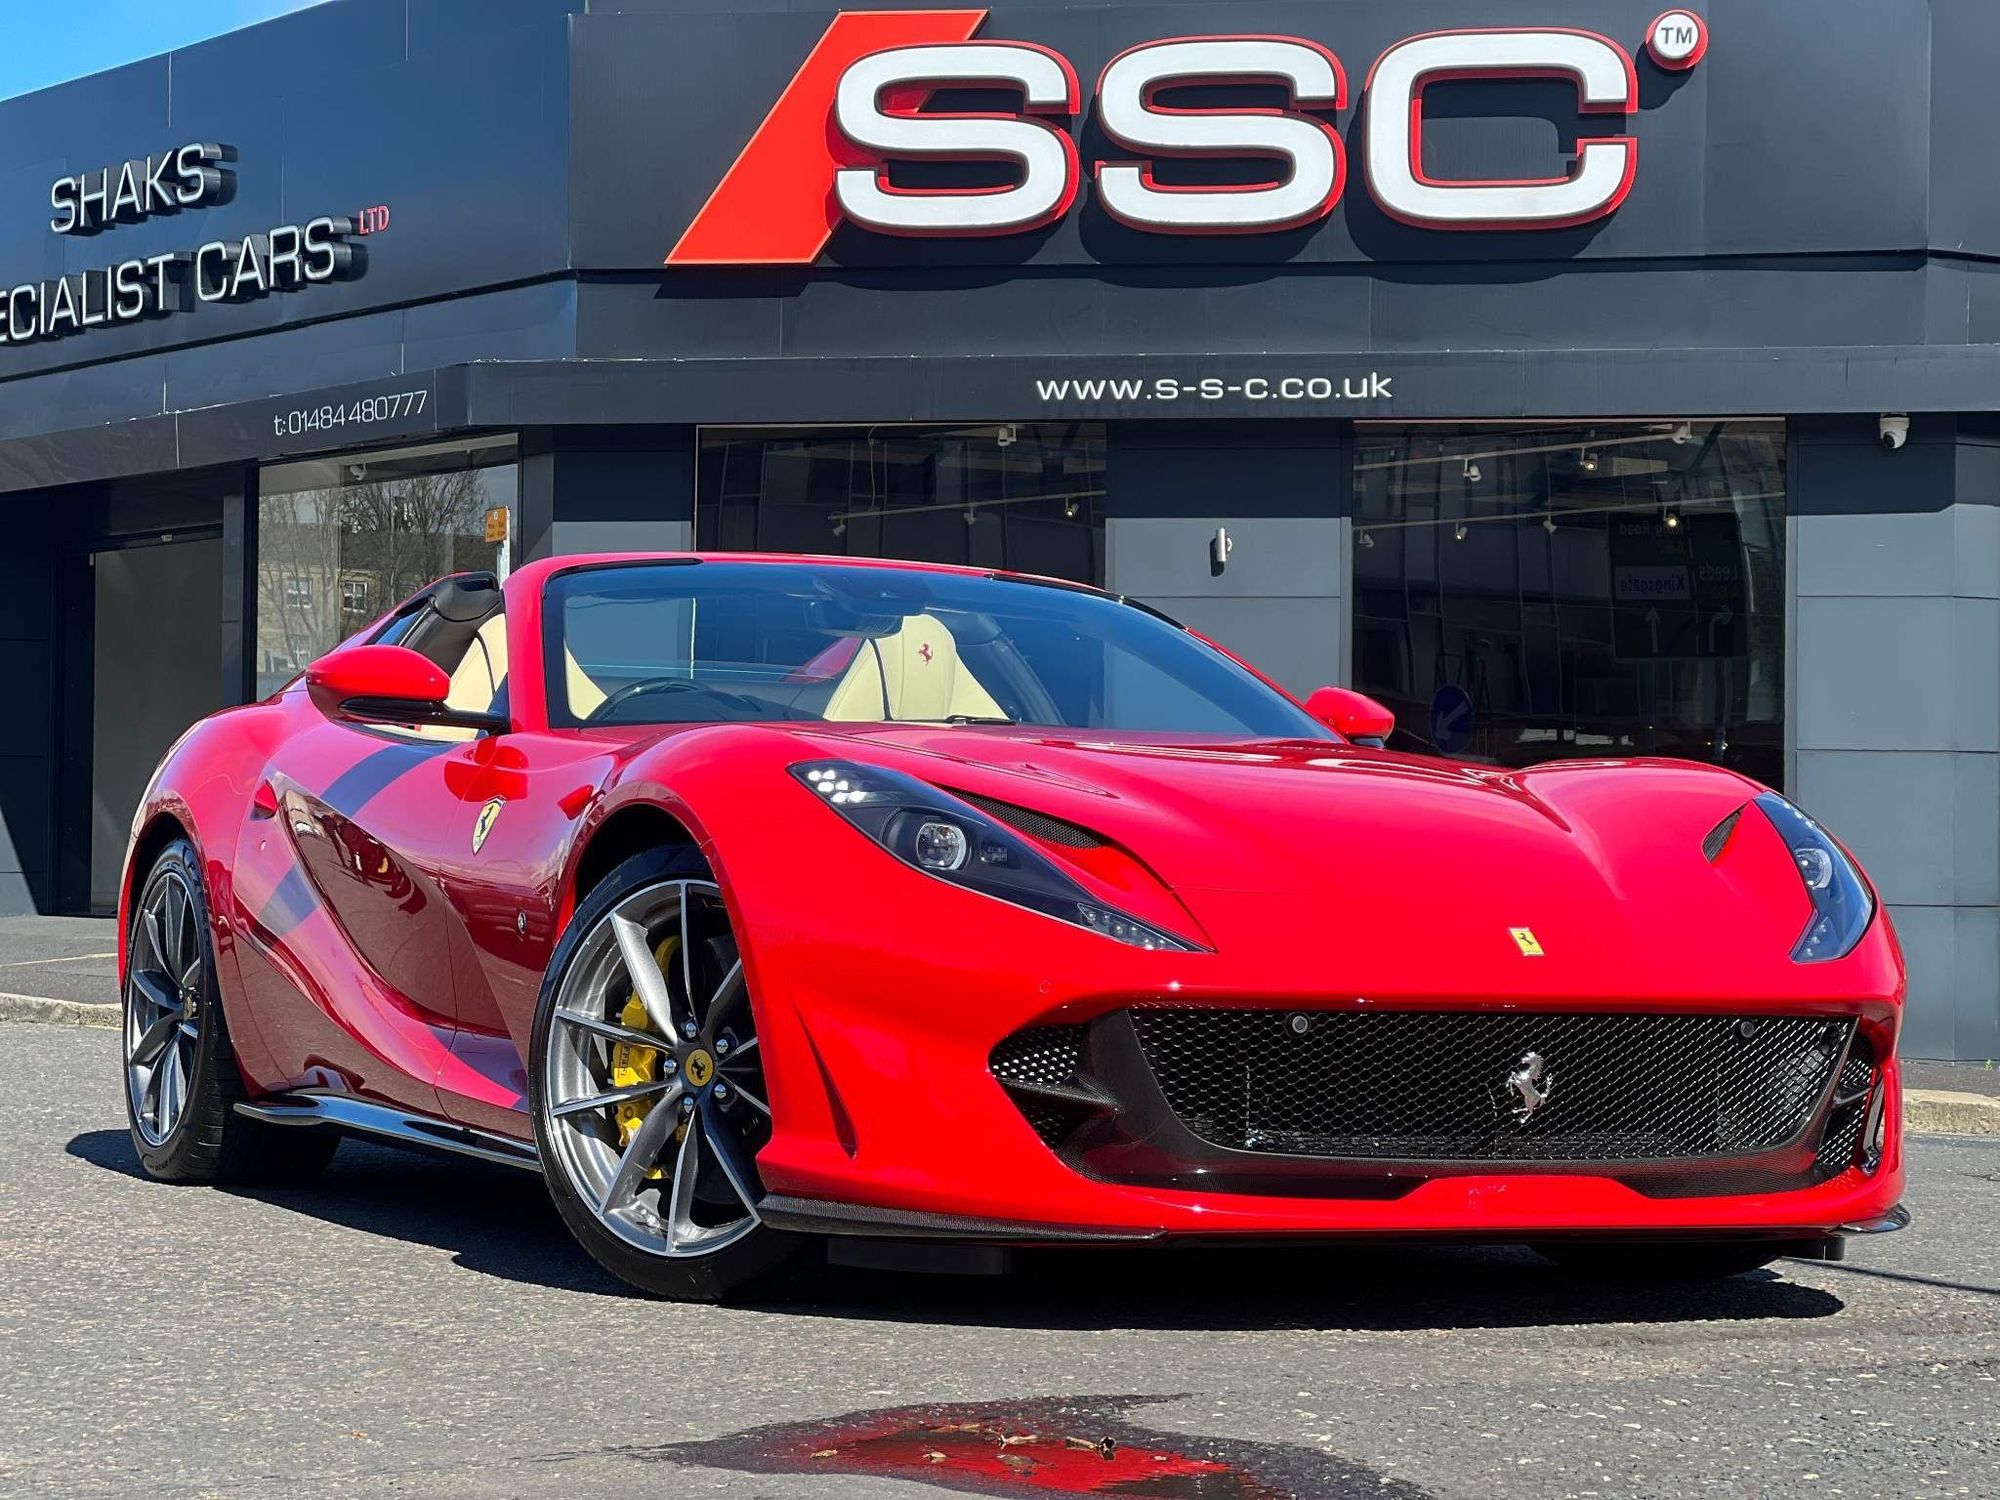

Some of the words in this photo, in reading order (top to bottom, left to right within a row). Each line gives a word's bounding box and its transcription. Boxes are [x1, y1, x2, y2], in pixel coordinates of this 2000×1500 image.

[1660, 26, 1693, 44] TM
[834, 28, 1638, 236] SSC
[50, 141, 206, 234] SHAKS
[197, 216, 336, 302] CARS
[359, 205, 391, 235] LTD
[1036, 371, 1393, 400] www.s-s-c.co.uk
